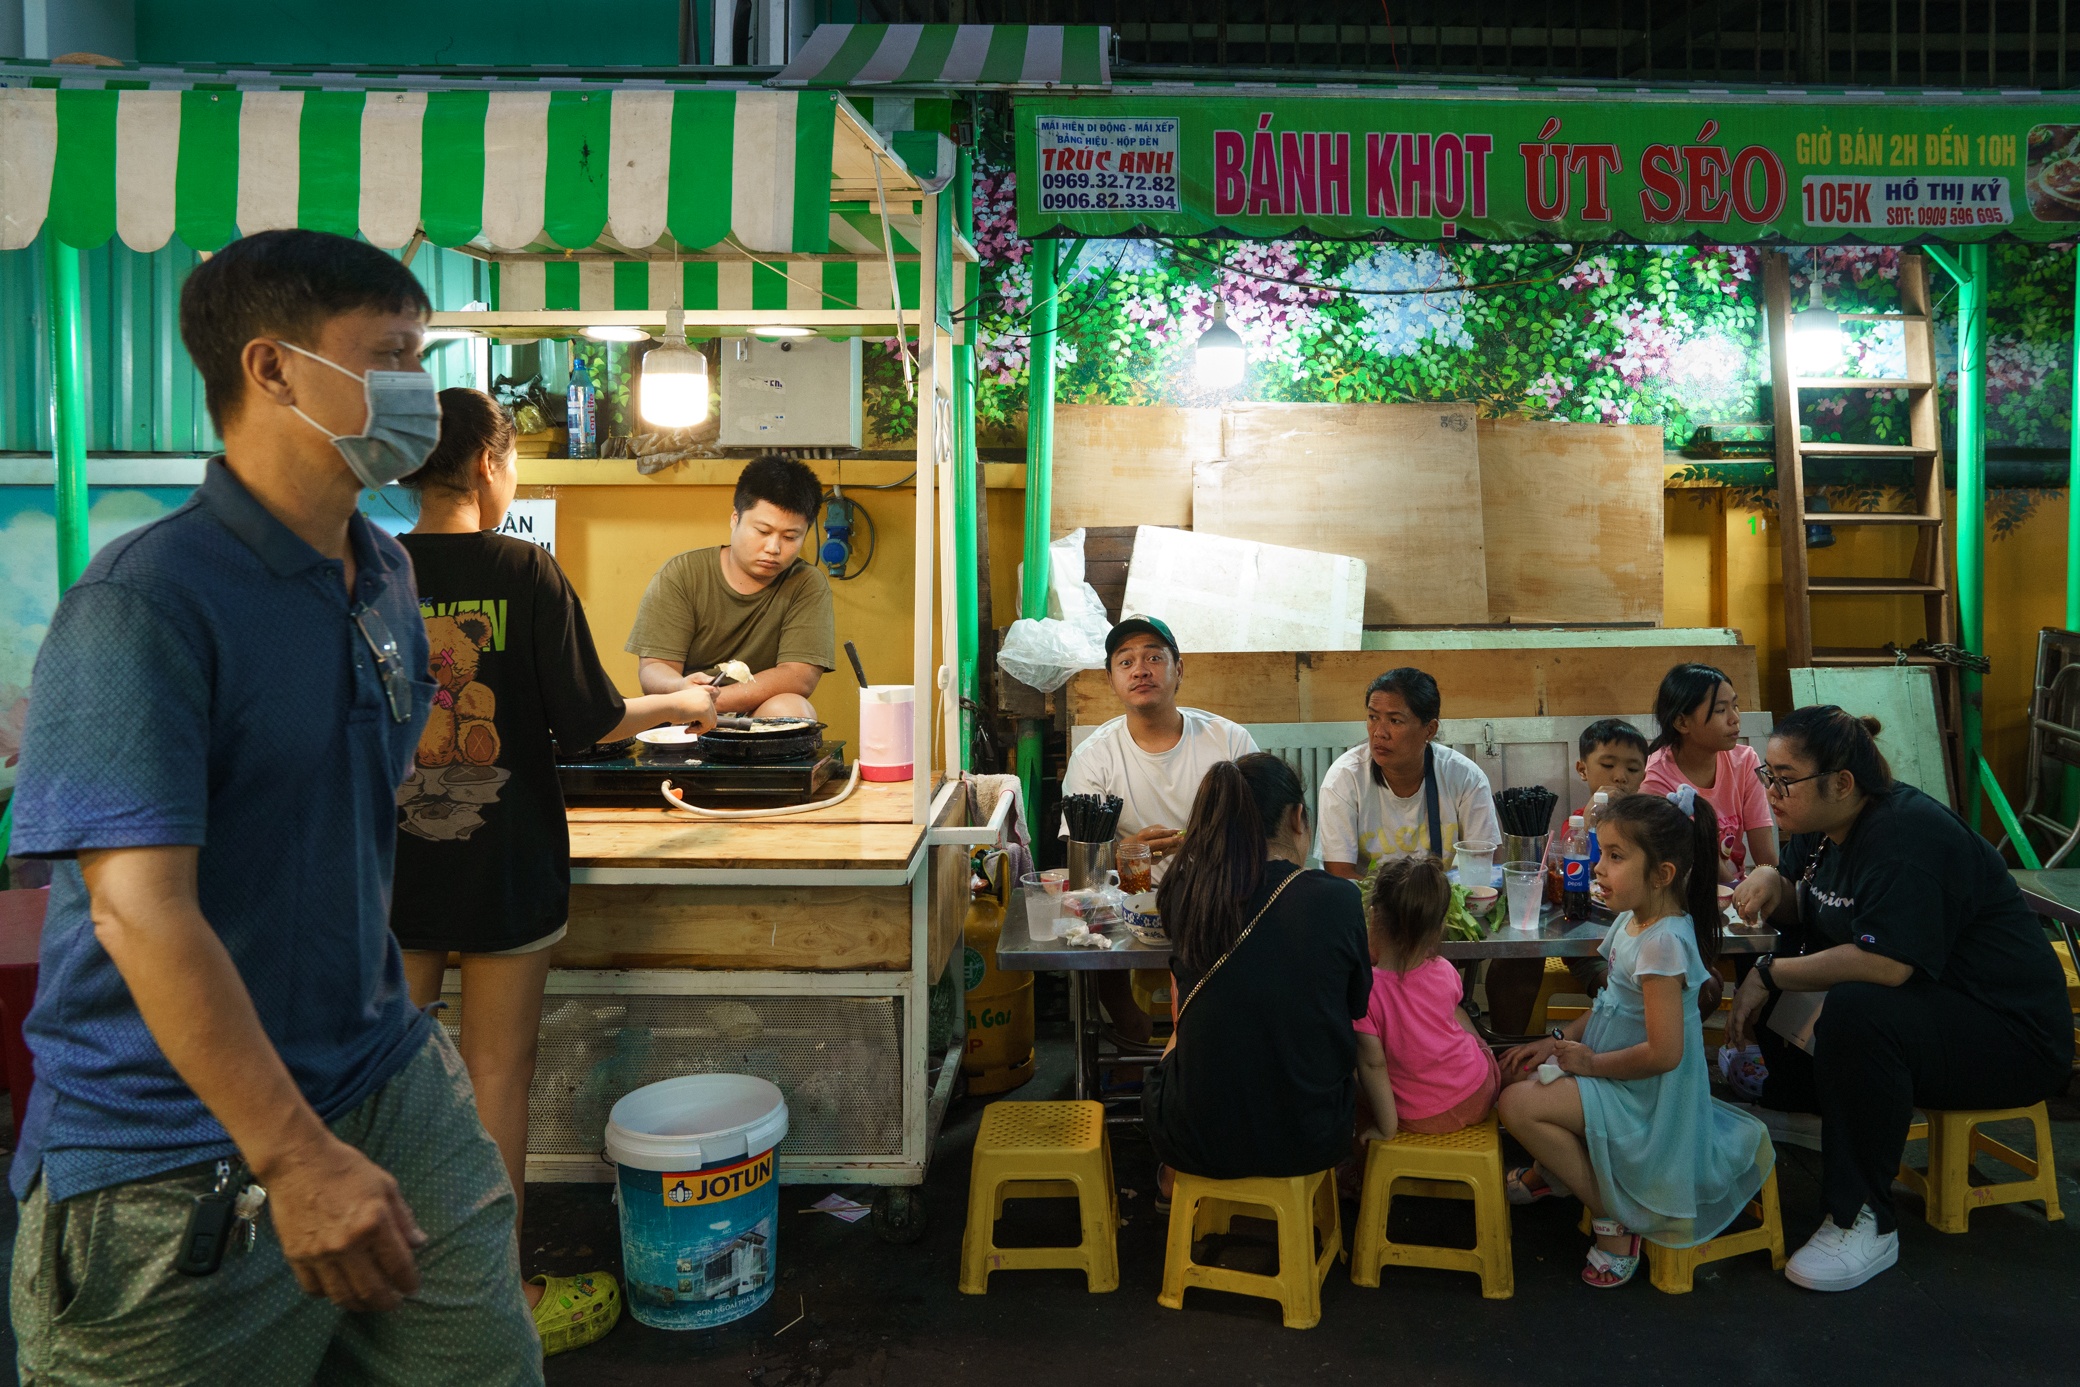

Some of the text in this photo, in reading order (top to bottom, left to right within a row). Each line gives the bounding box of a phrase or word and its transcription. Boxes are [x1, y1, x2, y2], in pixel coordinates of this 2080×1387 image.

[1041, 121, 1059, 131] MÁI
[1062, 121, 1085, 132] HIÊN
[1087, 124, 1097, 132] DI
[1100, 122, 1126, 134] ĐỘNG
[1134, 122, 1153, 133] MÁI
[1156, 121, 1175, 133] XẾP
[1057, 133, 1083, 145] BẢNG
[1085, 136, 1108, 147] HIỆU
[1116, 136, 1136, 147] HỘP
[1139, 135, 1159, 146] ĐÈN
[1796, 125, 2017, 167] GIỜ BÁN 2H ĐẾN 10H
[1042, 146, 1175, 174] TRÚC ANH
[1042, 173, 1176, 192] 0969.32.72.82
[1213, 112, 1788, 237] BÁNH KHỌT ÚT SÉO
[1043, 192, 1177, 210] 0906.82.33.94
[1803, 182, 1872, 223] 105K
[1927, 183, 1964, 205] THỊ
[1971, 178, 2002, 201] KỶ
[1886, 206, 2003, 226] SĐT: 0909 596 695
[495, 511, 533, 534] ẦN
[981, 1008, 1011, 1029] Gas
[696, 1157, 770, 1201] JOTUN
